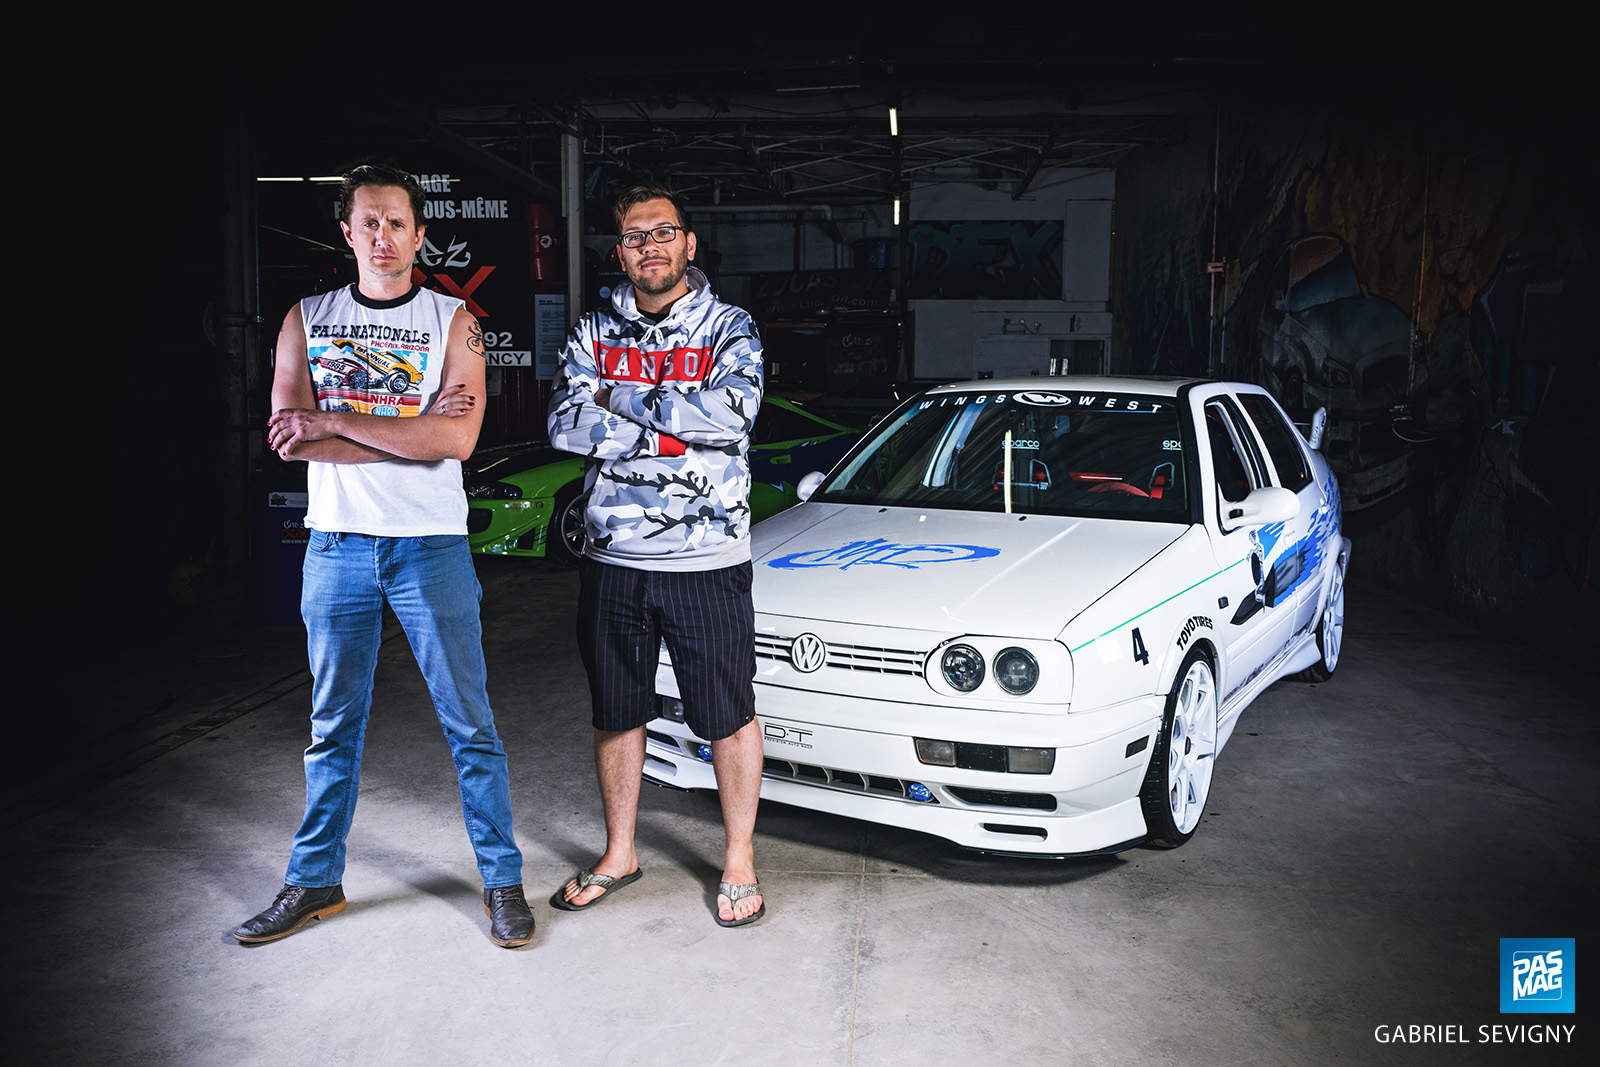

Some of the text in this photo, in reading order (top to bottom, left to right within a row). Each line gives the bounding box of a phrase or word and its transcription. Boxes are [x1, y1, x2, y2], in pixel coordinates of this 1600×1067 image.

[423, 196, 509, 219] OUS-MÊME
[486, 353, 525, 365] NCY
[600, 348, 711, 380] ANSO
[370, 394, 405, 406] NHRA
[919, 393, 1007, 411] WINGS
[1078, 395, 1162, 414] WEST
[1131, 627, 1150, 666] 4
